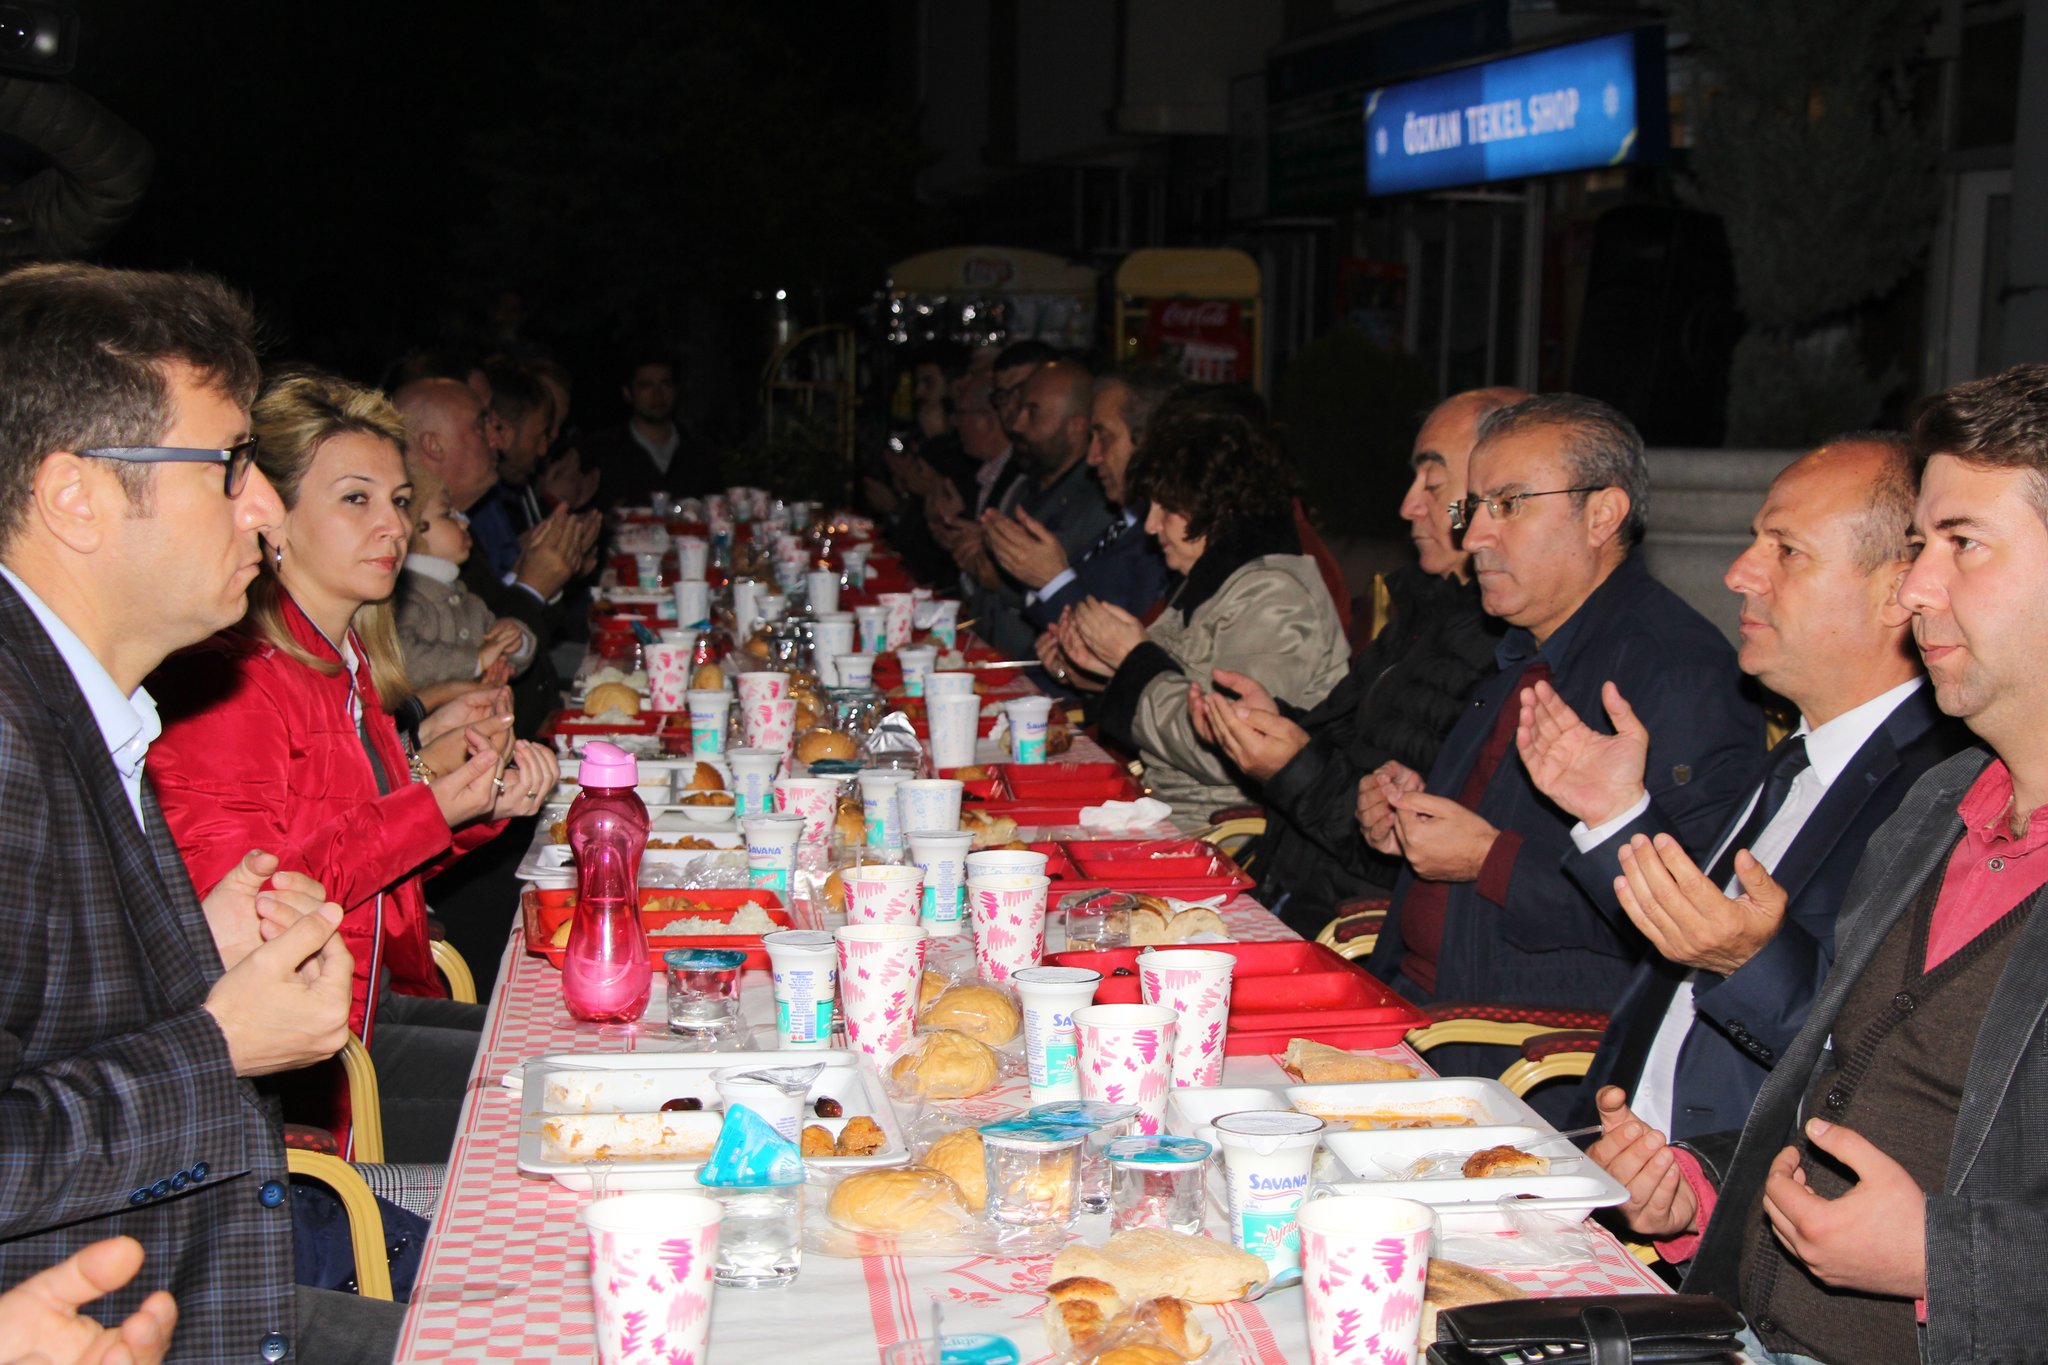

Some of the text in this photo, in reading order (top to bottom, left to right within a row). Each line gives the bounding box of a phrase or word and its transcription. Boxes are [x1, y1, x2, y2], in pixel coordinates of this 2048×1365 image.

[1403, 87, 1580, 156] ÖZKAN TEKEL SHOP
[1249, 1173, 1308, 1190] SAVANA
